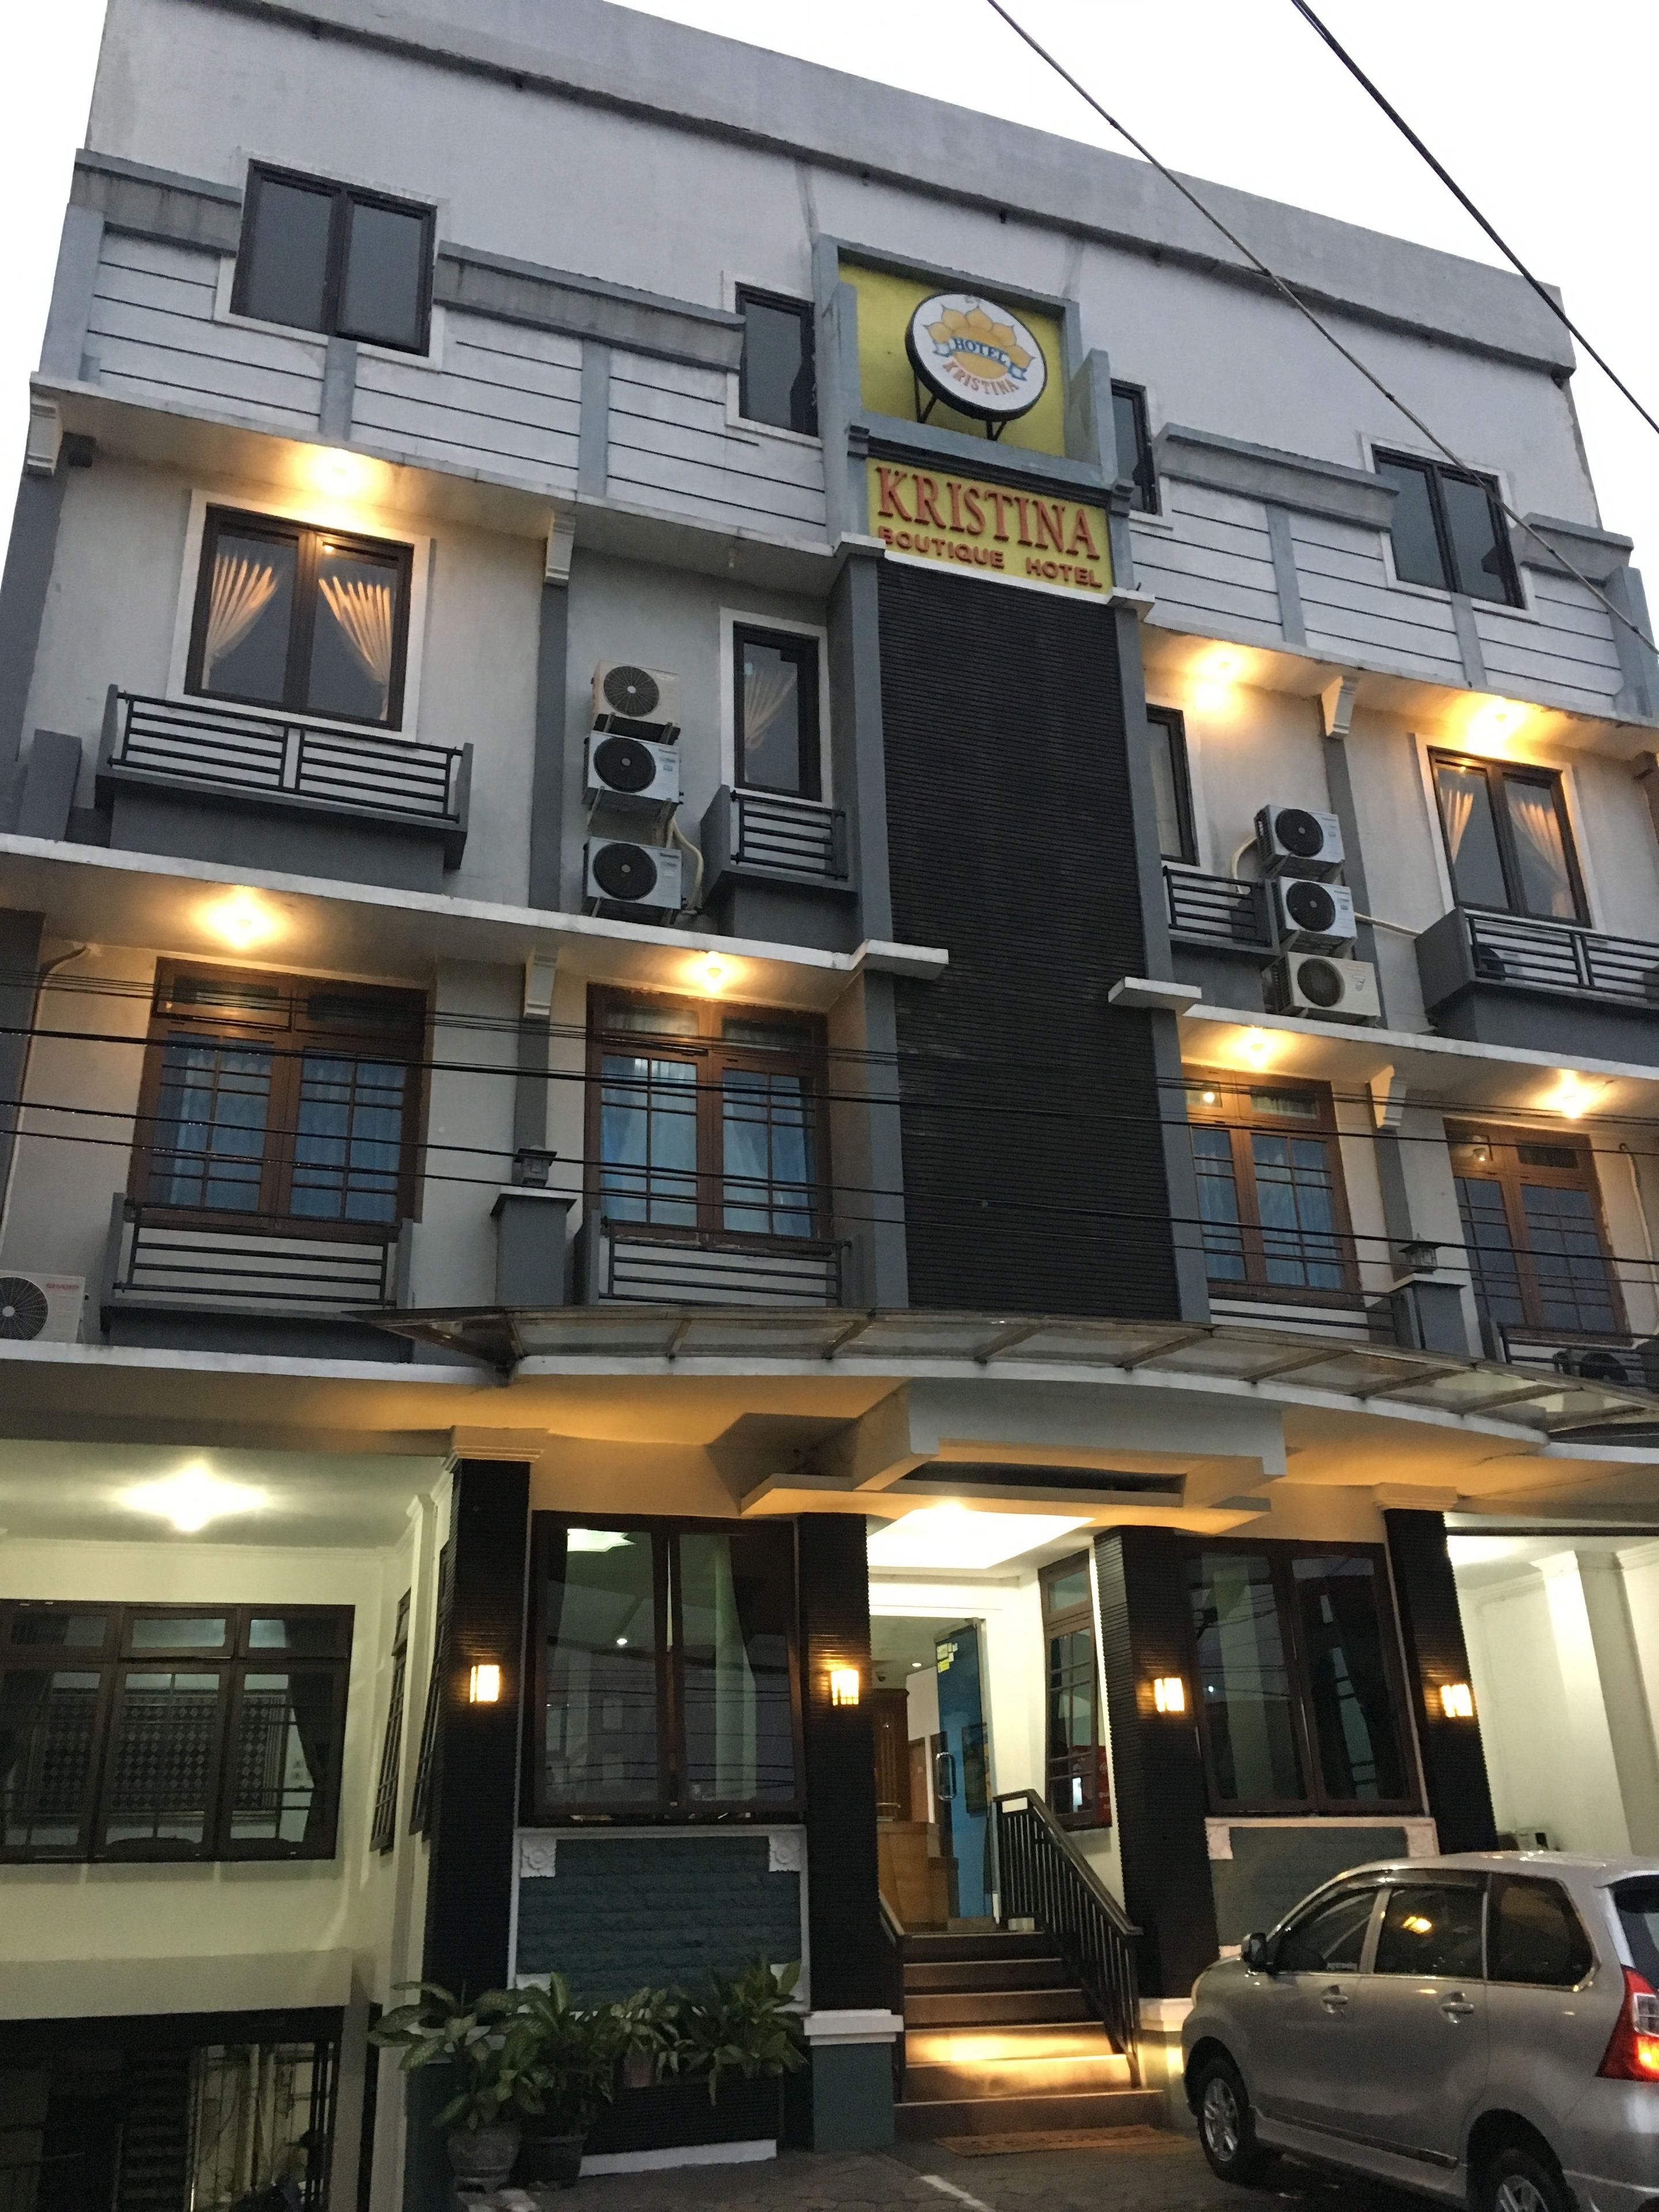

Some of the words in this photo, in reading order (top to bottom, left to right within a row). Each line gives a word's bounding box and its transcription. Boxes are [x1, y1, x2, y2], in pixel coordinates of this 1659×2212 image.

[953, 337, 1008, 364] HOTEL
[942, 360, 1019, 395] KRISTINA
[876, 465, 1101, 560] KRISTINA
[878, 527, 1005, 569] BOUTIQUE
[1025, 556, 1103, 588] HOTEL
